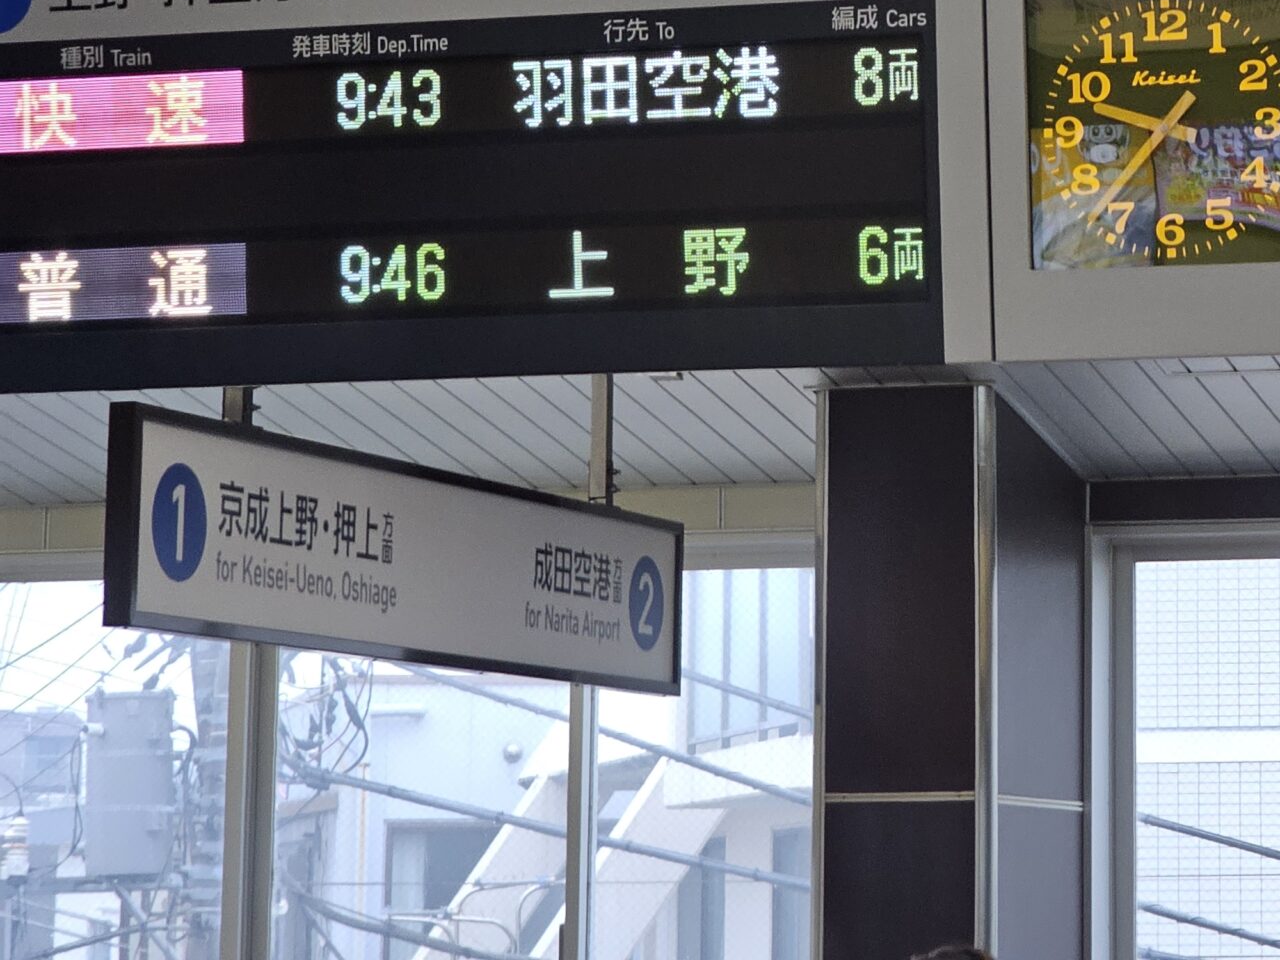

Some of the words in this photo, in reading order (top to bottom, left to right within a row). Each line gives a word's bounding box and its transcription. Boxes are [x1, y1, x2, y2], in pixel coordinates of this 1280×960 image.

[603, 17, 649, 43] 行先
[655, 21, 675, 40] To
[831, 4, 879, 31] 編成
[885, 8, 927, 28] Cars
[1142, 9, 1187, 41] 12
[292, 31, 371, 59] 発車時刻
[377, 33, 449, 56] Dep.Time
[1099, 31, 1138, 64] 11
[1207, 22, 1226, 54] 1
[60, 44, 104, 70] 種別
[110, 48, 152, 68] Train
[1067, 71, 1111, 104] 10
[1131, 69, 1201, 87] Keisei
[1239, 59, 1268, 91] 2
[14, 75, 208, 149] 快速
[336, 68, 442, 130] 9:43
[512, 46, 780, 127] 羽田空港
[853, 46, 919, 106] 8両
[1055, 116, 1084, 149] 9
[1071, 163, 1100, 195] 8
[1240, 156, 1269, 189] 4
[1107, 201, 1135, 234] 7
[1155, 213, 1185, 246] 6
[1205, 196, 1234, 230] 5
[17, 248, 213, 323] 普通
[340, 242, 446, 304] 9:46
[548, 226, 750, 299] 上野
[857, 225, 925, 286] 6両
[171, 483, 186, 563] 1
[216, 552, 238, 582] for
[242, 554, 337, 600] Keisei-Ueno,
[341, 571, 397, 614] Oshiage
[638, 572, 654, 635] 2
[525, 601, 543, 630] for
[544, 604, 580, 634] Narita
[582, 608, 621, 644] Airport
